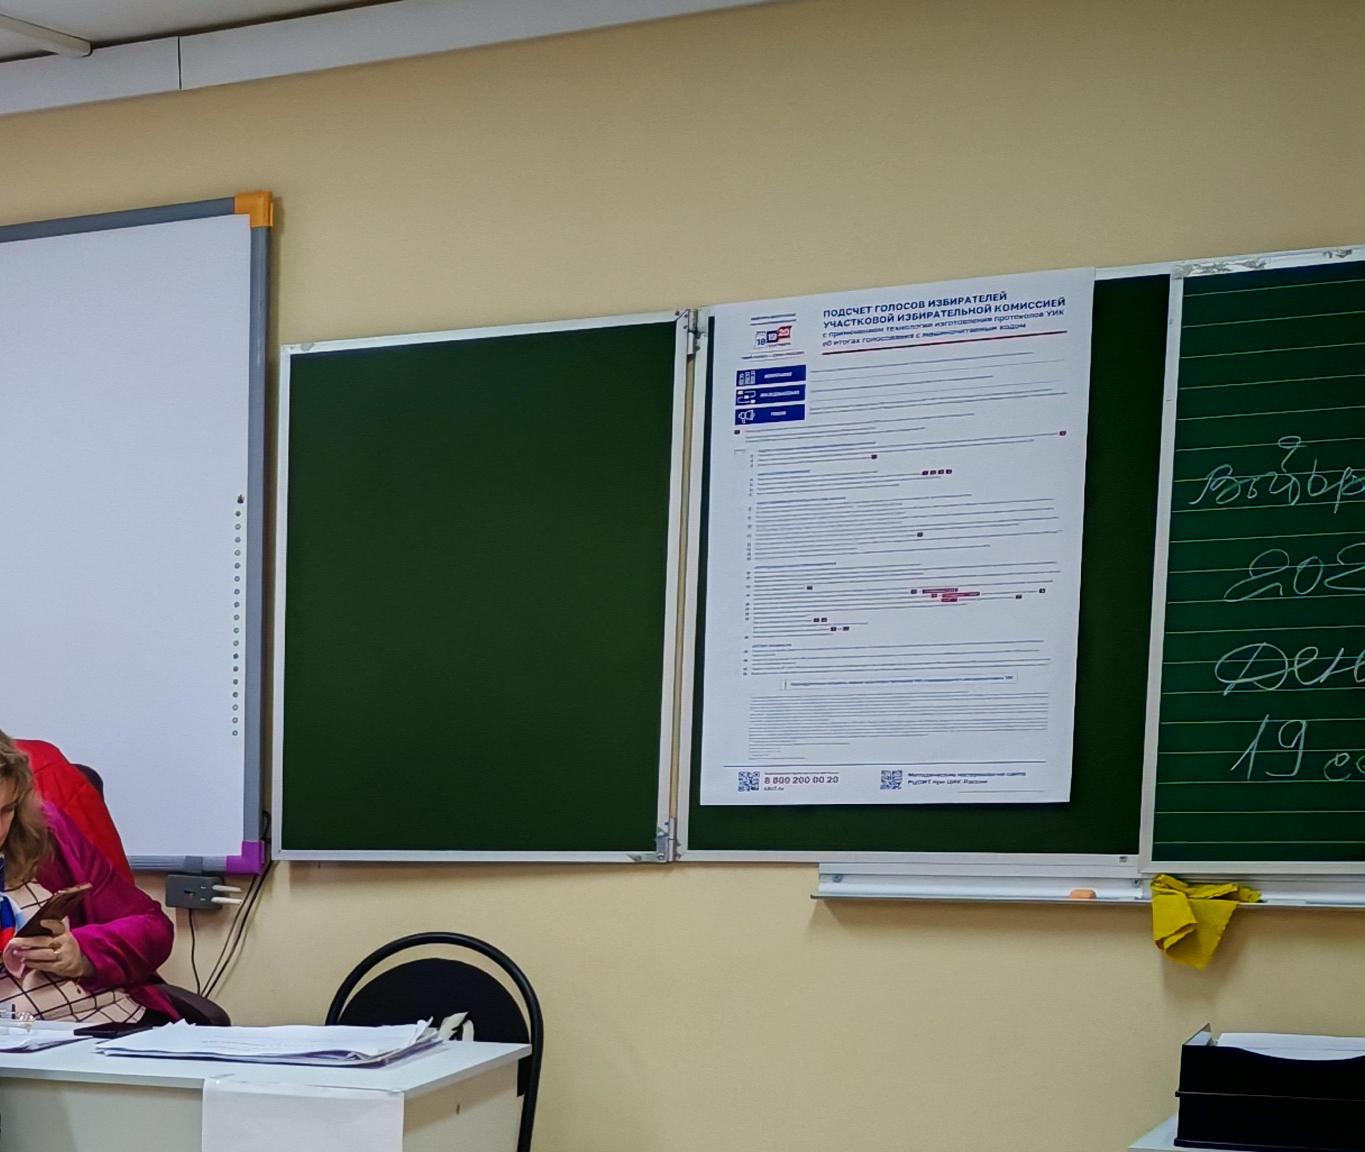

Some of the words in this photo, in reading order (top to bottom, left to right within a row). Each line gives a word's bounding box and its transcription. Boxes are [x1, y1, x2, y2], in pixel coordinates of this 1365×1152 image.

[823, 306, 873, 318] ПОДСЧЕТ
[874, 300, 925, 313] ГОЛОСОВ
[928, 291, 1007, 307] ИЗБИРАТЕЛЕЙ
[823, 313, 894, 328] УЧАСТКОВОЙ
[897, 304, 991, 322] ИЗБИРАТЕЛЬНОЙ
[994, 296, 1066, 312] КОМИССИЕЙ
[1230, 714, 1308, 780] 19
[792, 776, 810, 784] 200
[826, 776, 839, 784] 20
